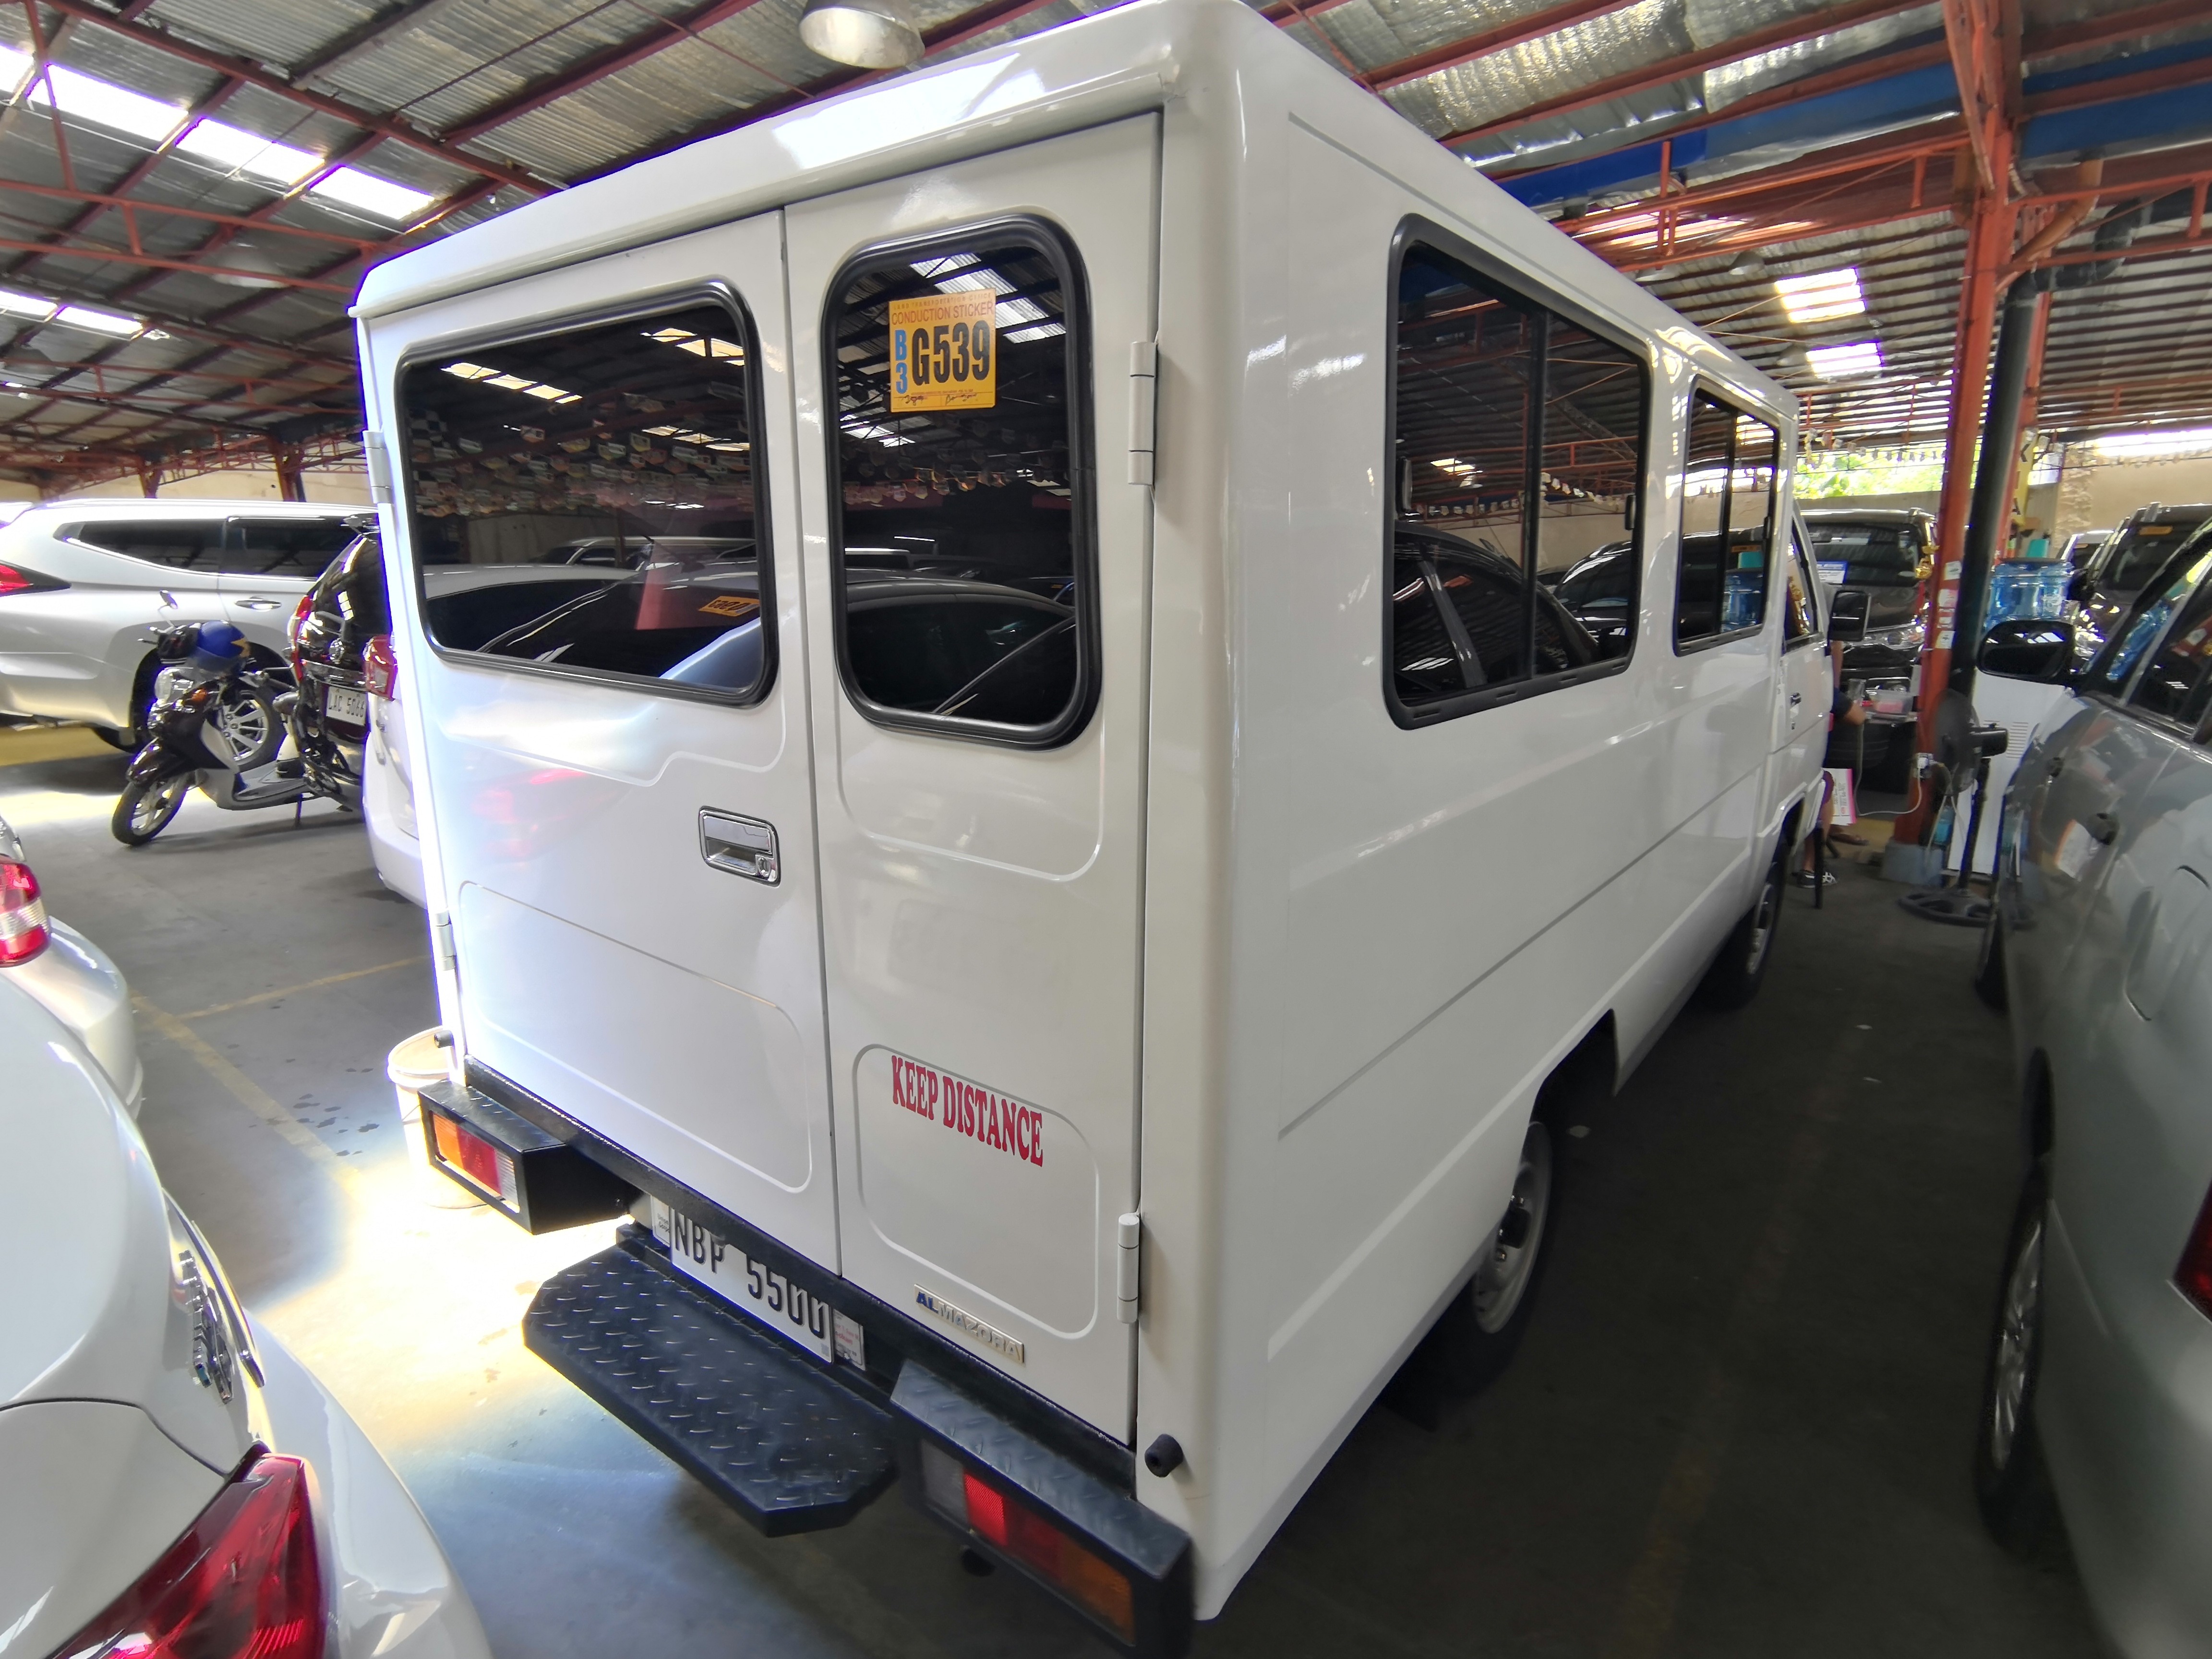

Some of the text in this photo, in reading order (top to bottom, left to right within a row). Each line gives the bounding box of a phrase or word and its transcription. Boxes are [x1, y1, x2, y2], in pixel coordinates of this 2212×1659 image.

[891, 301, 994, 325] CONDUCTION STICKER
[912, 320, 990, 385] G539
[891, 1055, 1043, 1167] KEEP DISTANCE
[916, 1291, 1021, 1361] ALMAZORA
